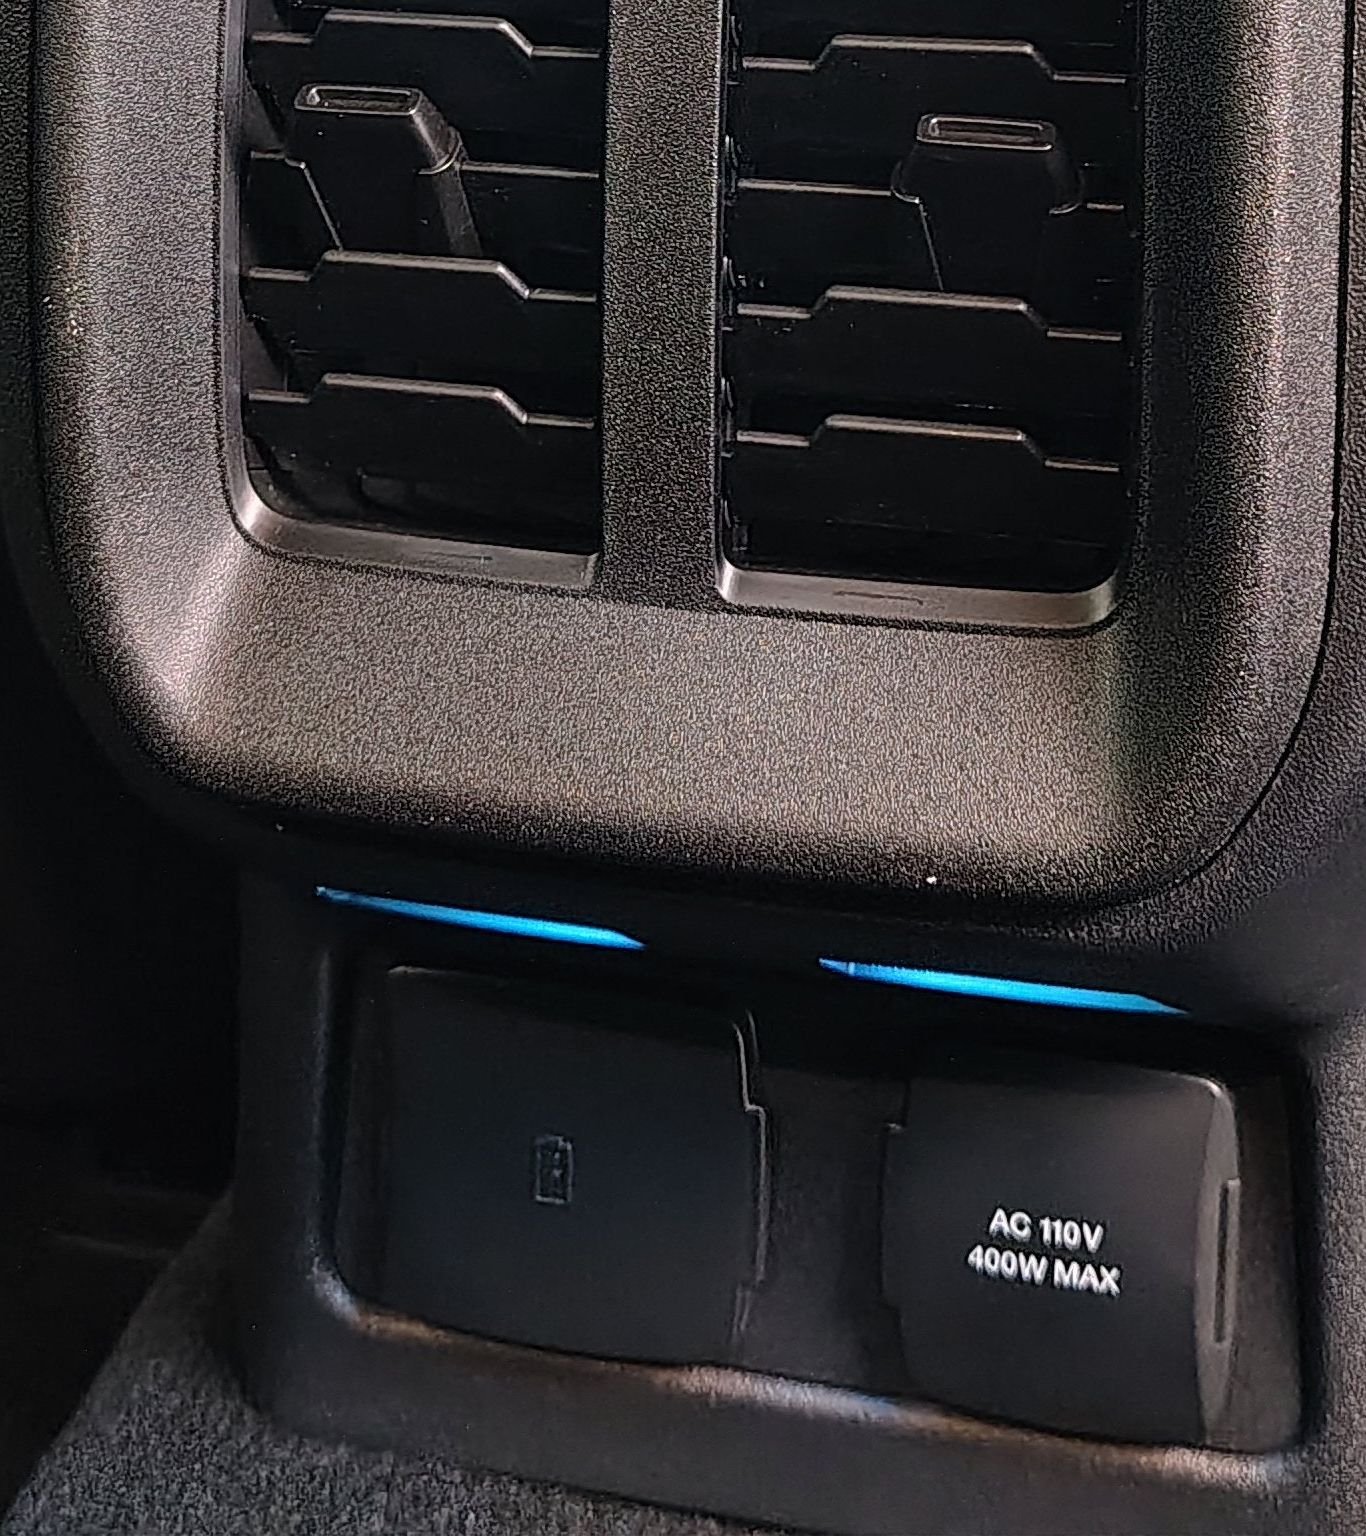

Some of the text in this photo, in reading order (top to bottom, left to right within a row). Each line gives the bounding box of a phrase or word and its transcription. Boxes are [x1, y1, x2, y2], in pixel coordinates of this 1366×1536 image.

[988, 1207, 1105, 1254] AC 110V
[967, 1244, 1121, 1297] 400W MAX
